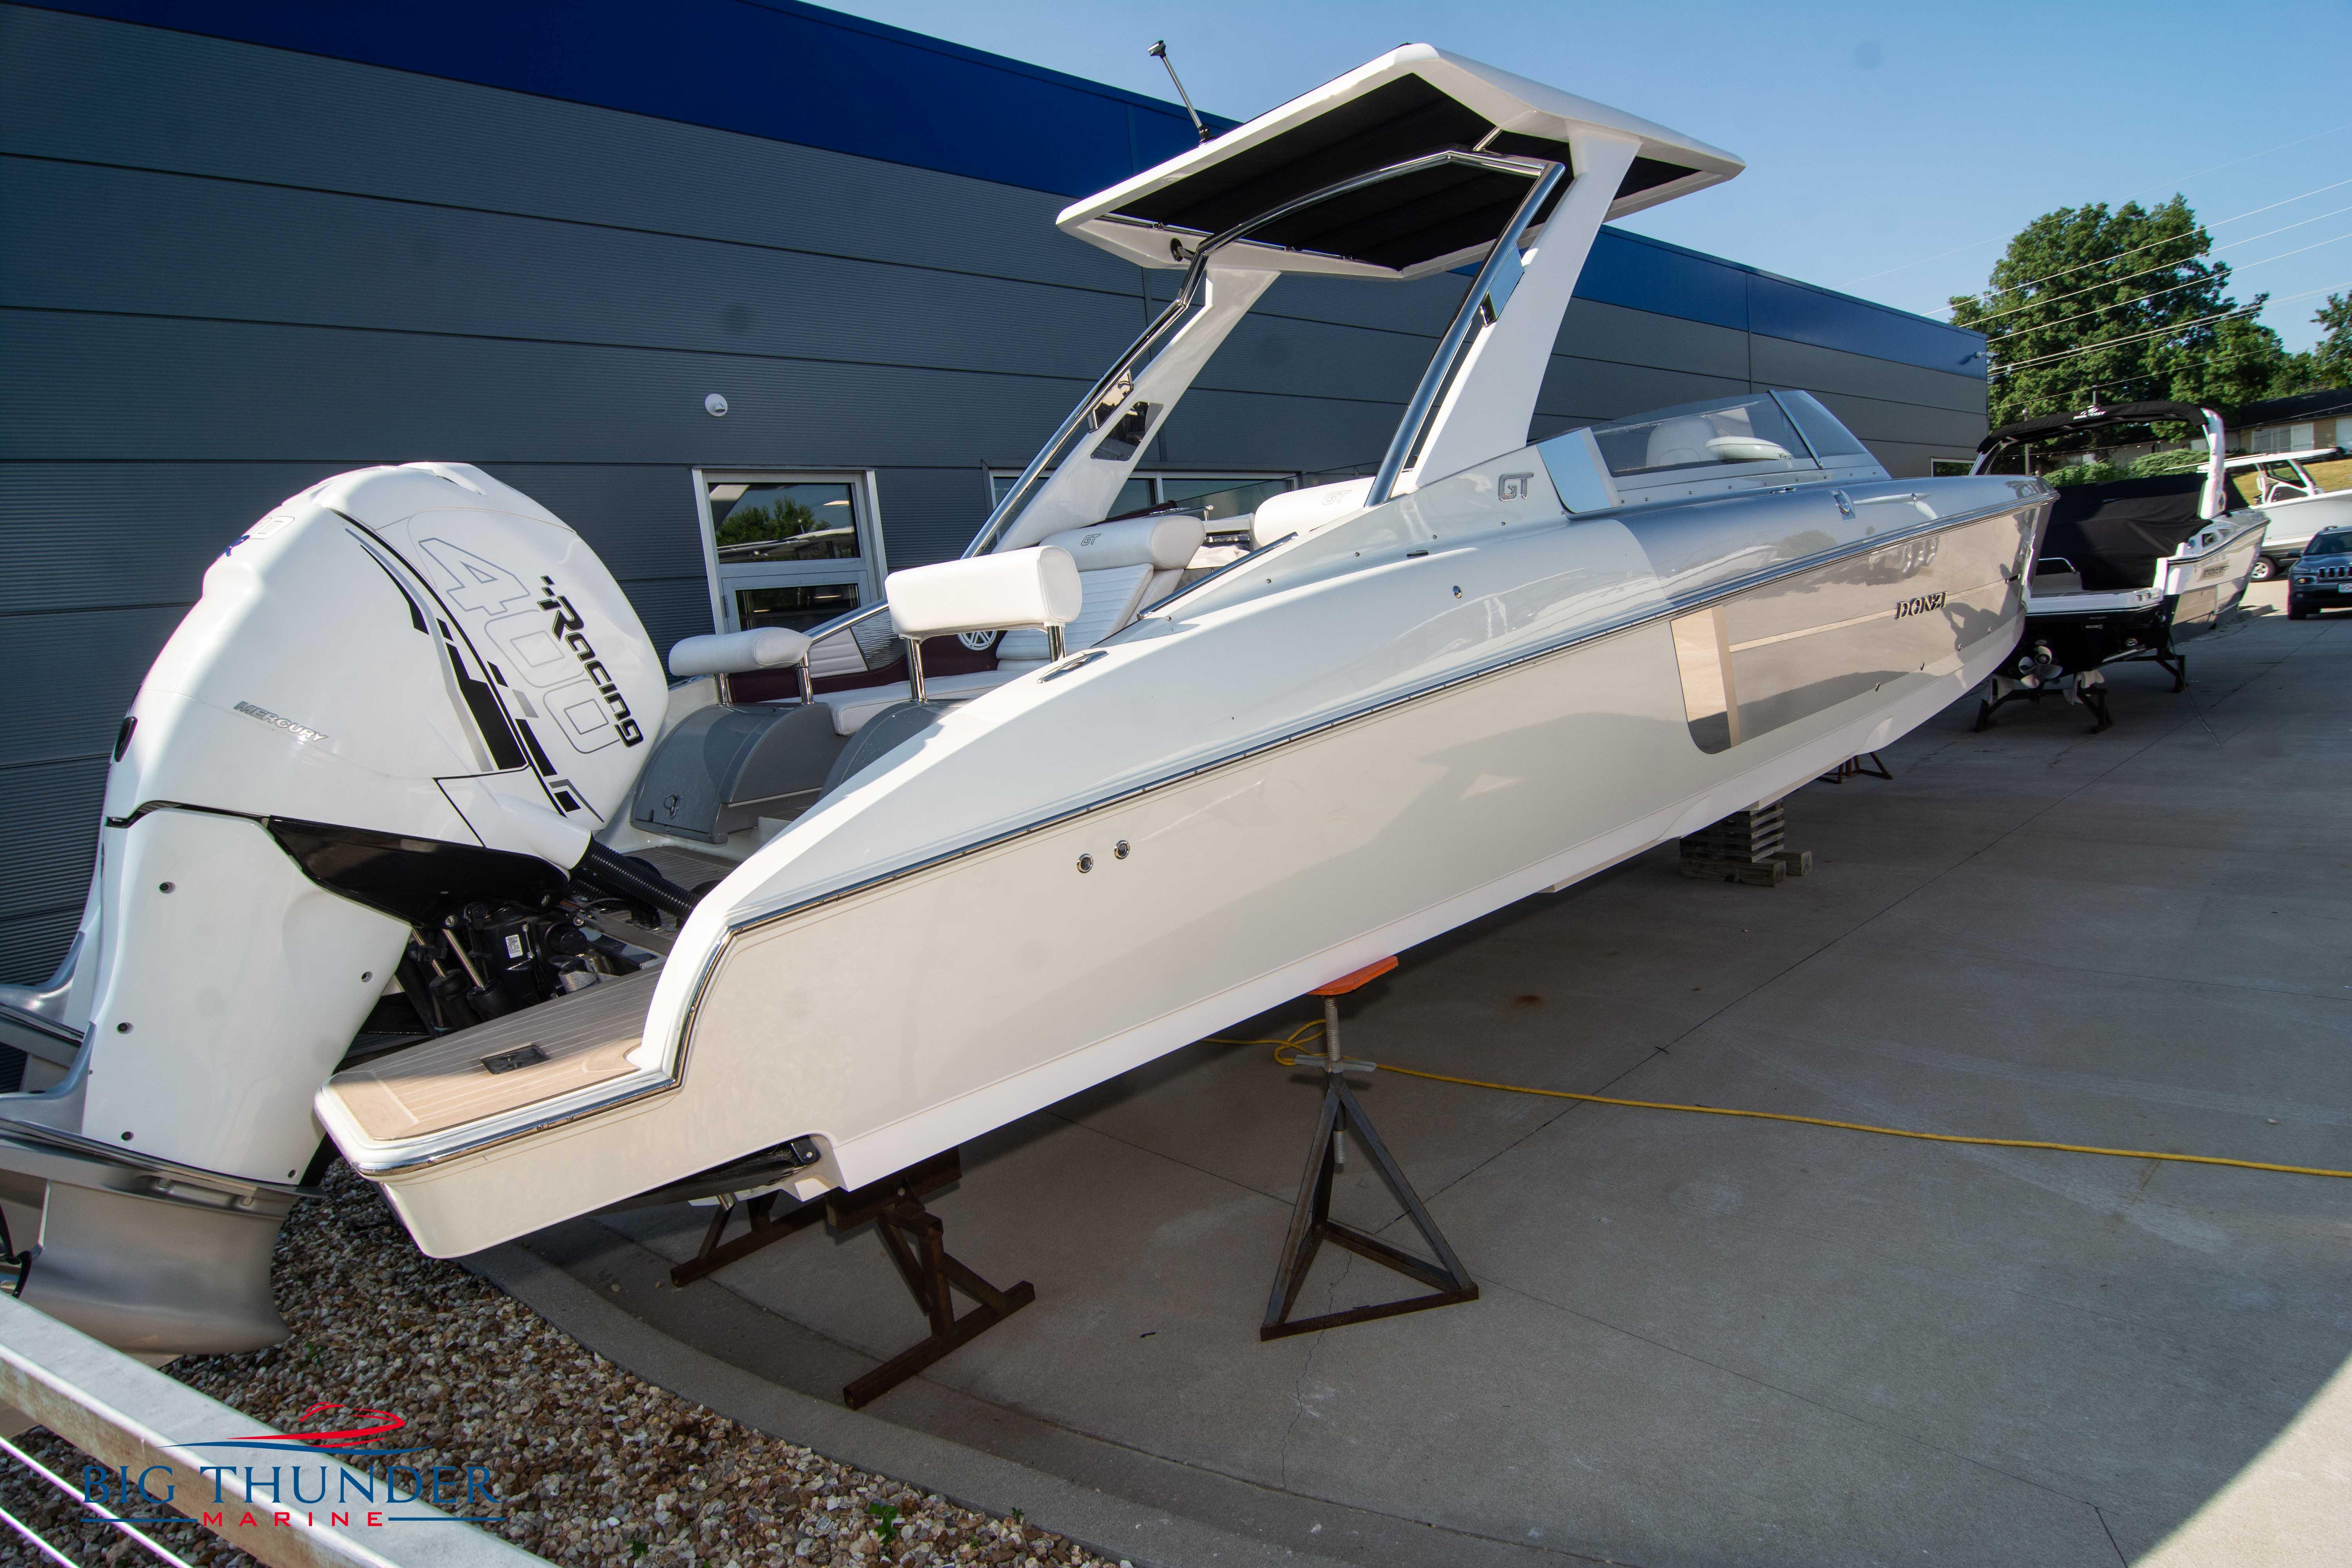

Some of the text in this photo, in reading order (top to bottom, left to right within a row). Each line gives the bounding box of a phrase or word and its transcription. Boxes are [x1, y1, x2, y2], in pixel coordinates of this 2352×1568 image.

[1322, 489, 1352, 505] GT
[1498, 473, 1534, 501] GT
[1081, 533, 1101, 546] GT
[1894, 591, 1948, 620] DONZI
[418, 537, 620, 753] 400
[537, 592, 643, 748] Racing
[234, 701, 328, 742] MERCURY
